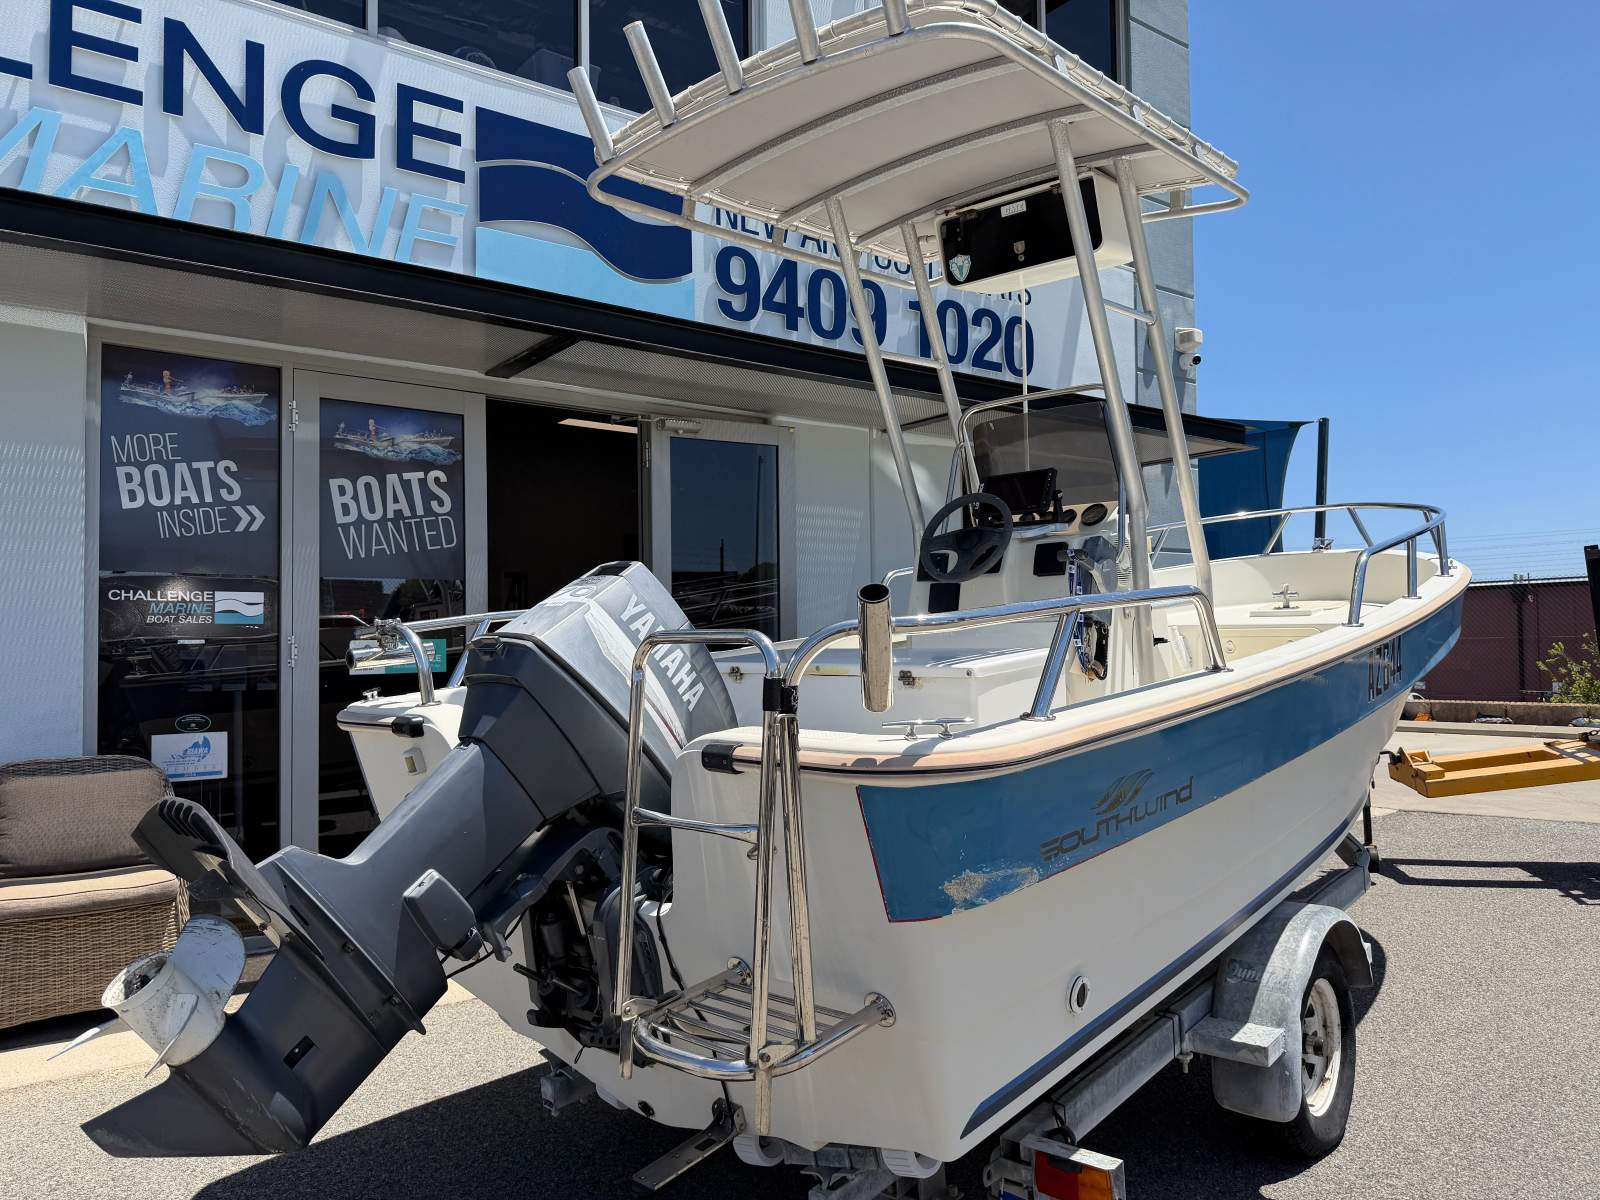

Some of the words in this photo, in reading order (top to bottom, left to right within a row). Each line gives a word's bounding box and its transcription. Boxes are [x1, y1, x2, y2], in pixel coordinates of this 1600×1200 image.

[0, 0, 466, 184] ENGE
[715, 246, 888, 348] 9409
[908, 299, 1035, 378] 1020
[110, 432, 182, 463] MORE
[115, 459, 242, 510] BOATS
[328, 469, 452, 525] BOATS
[157, 506, 231, 539] INSIDE
[337, 515, 457, 560] WANTED
[108, 589, 214, 602] CHALLENGE
[149, 602, 214, 614] MARINE
[146, 615, 176, 624] BOAT
[178, 615, 213, 624] SALES
[620, 593, 705, 713] YAAHA
